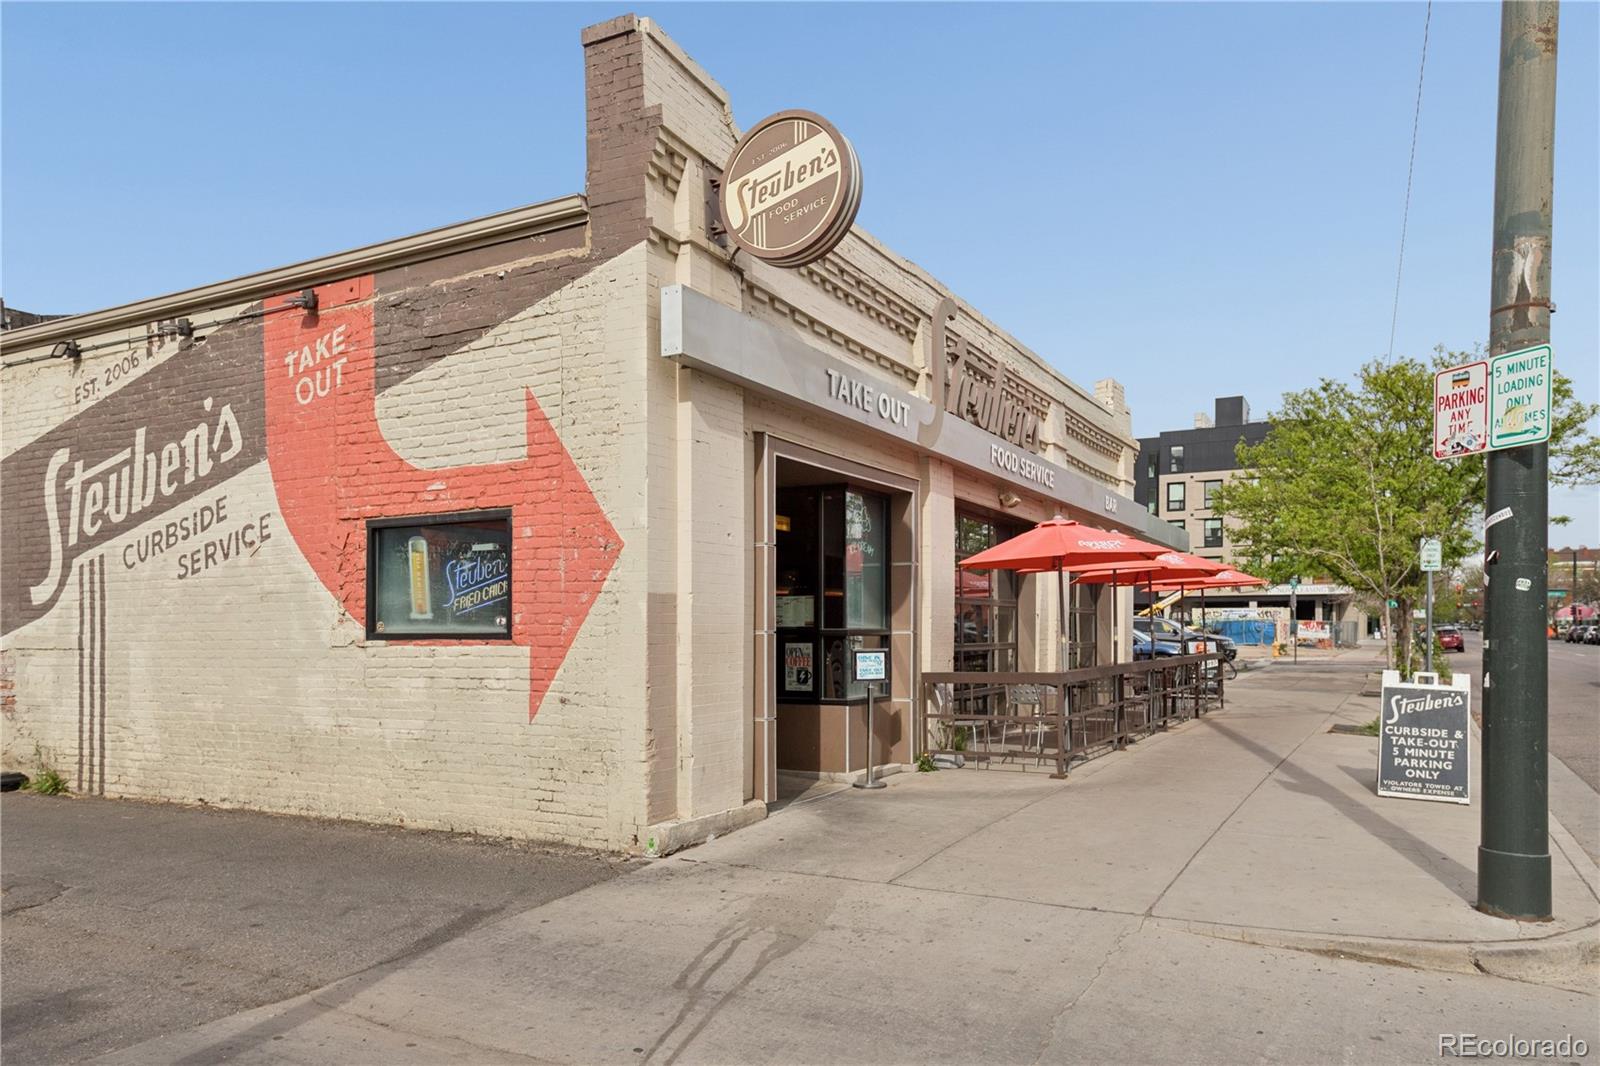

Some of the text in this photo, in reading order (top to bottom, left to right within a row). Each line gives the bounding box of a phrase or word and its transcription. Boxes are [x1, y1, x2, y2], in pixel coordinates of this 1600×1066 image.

[734, 147, 837, 236] Steuben's
[769, 198, 799, 219] FOOD
[784, 196, 828, 224] SERVICE
[284, 324, 347, 378] TAKE
[74, 350, 139, 404] EST. 2006
[1496, 355, 1547, 379] 5 MINUTE
[295, 357, 348, 405] OUT
[1497, 374, 1543, 395] LOADING
[827, 368, 911, 427] TAKE OUT
[1438, 387, 1484, 412] PARKING
[1506, 393, 1533, 409] ONLY
[1450, 408, 1471, 422] ANY
[991, 444, 1055, 489] FOOD SERVICE
[30, 397, 243, 605] Steuben's
[1105, 495, 1118, 514] BAR
[122, 495, 228, 570] CURBSIDE
[177, 513, 272, 581] SERVICE
[442, 553, 508, 607] Steuben'
[453, 590, 480, 611] FRIED
[1386, 693, 1464, 724] Steuben's
[1385, 725, 1464, 740] CURBSIDE &
[1390, 736, 1458, 749] TAKE-OUT
[1392, 747, 1455, 760] 5 MINUTE
[1394, 758, 1453, 770] PARKING
[1383, 780, 1423, 788] VIOLATORS
[1405, 769, 1440, 780] ONLY
[1423, 788, 1455, 796] EXPENSE
